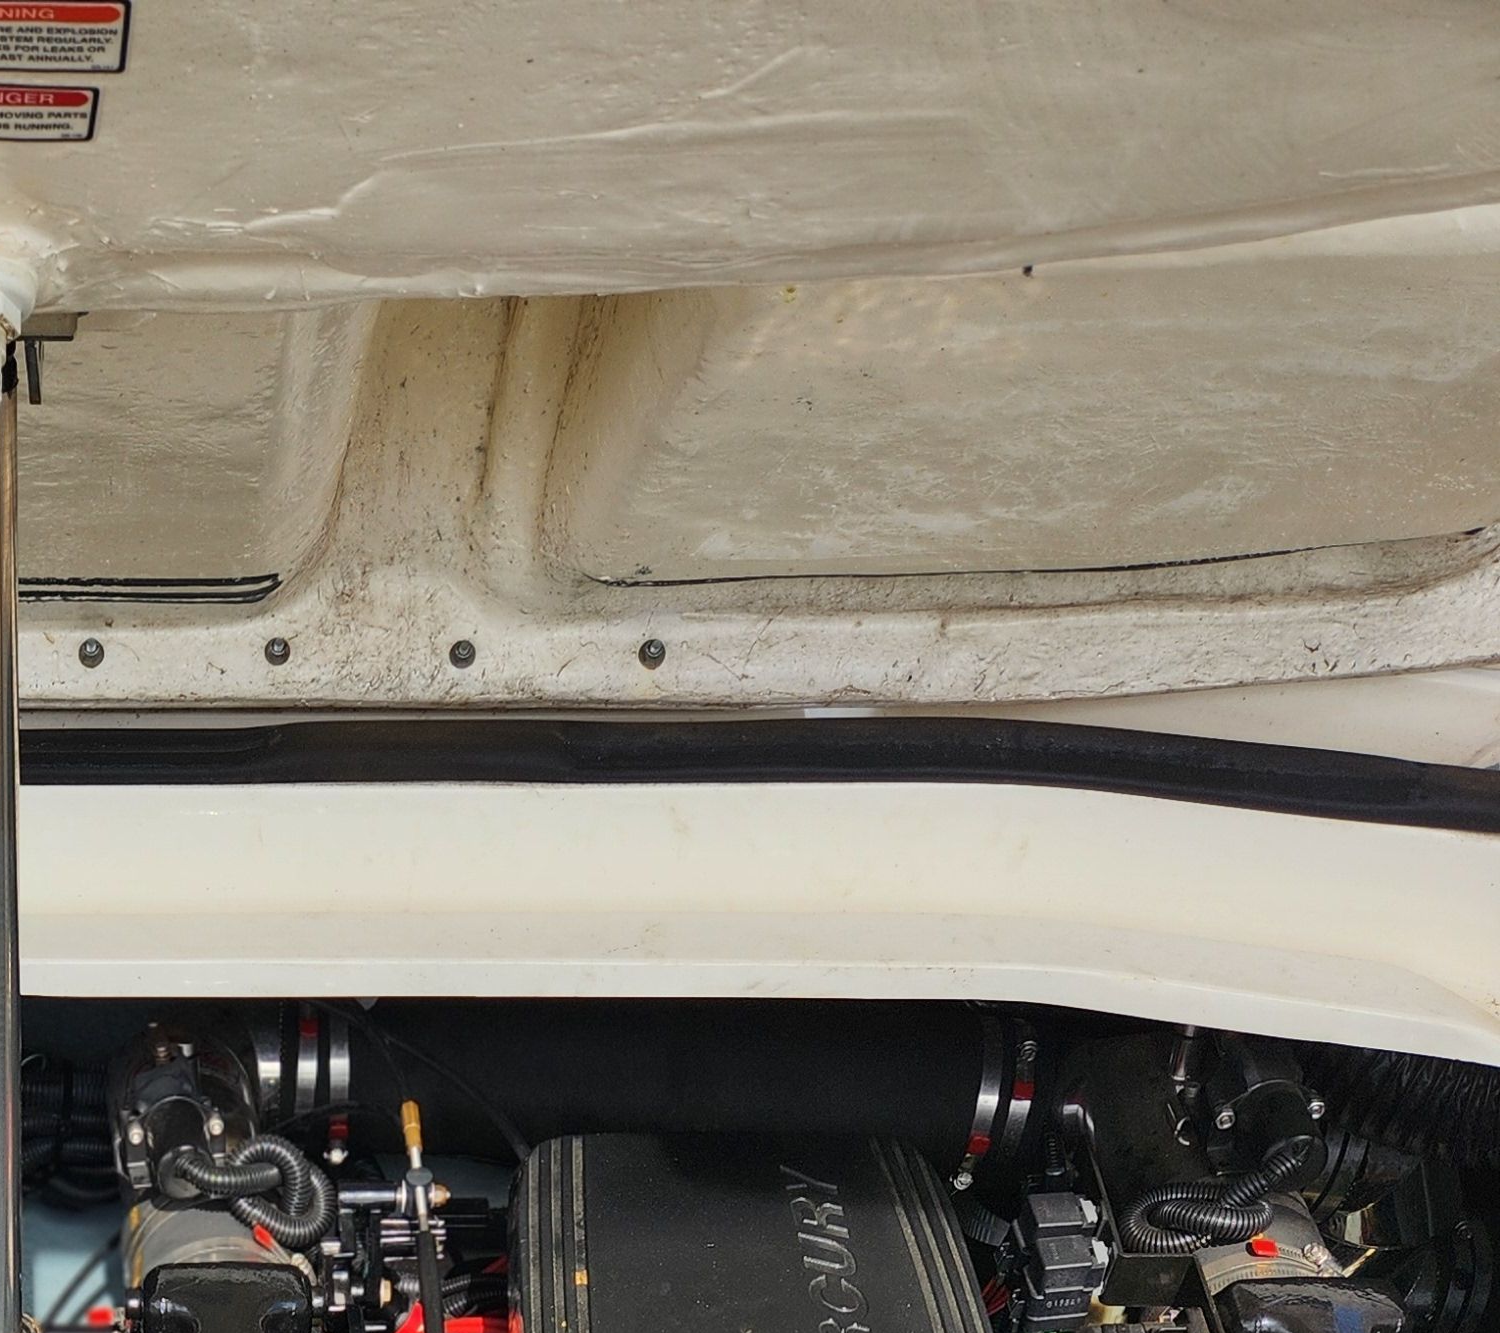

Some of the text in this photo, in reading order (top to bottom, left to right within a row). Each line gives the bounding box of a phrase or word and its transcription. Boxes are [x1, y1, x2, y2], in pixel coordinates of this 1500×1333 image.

[17, 26, 42, 34] AND
[47, 27, 117, 36] EXPLOSION
[37, 36, 114, 44] REGULARLY.
[48, 112, 88, 120] PARTS
[0, 122, 10, 130] IS
[14, 122, 74, 130] RUNNING.
